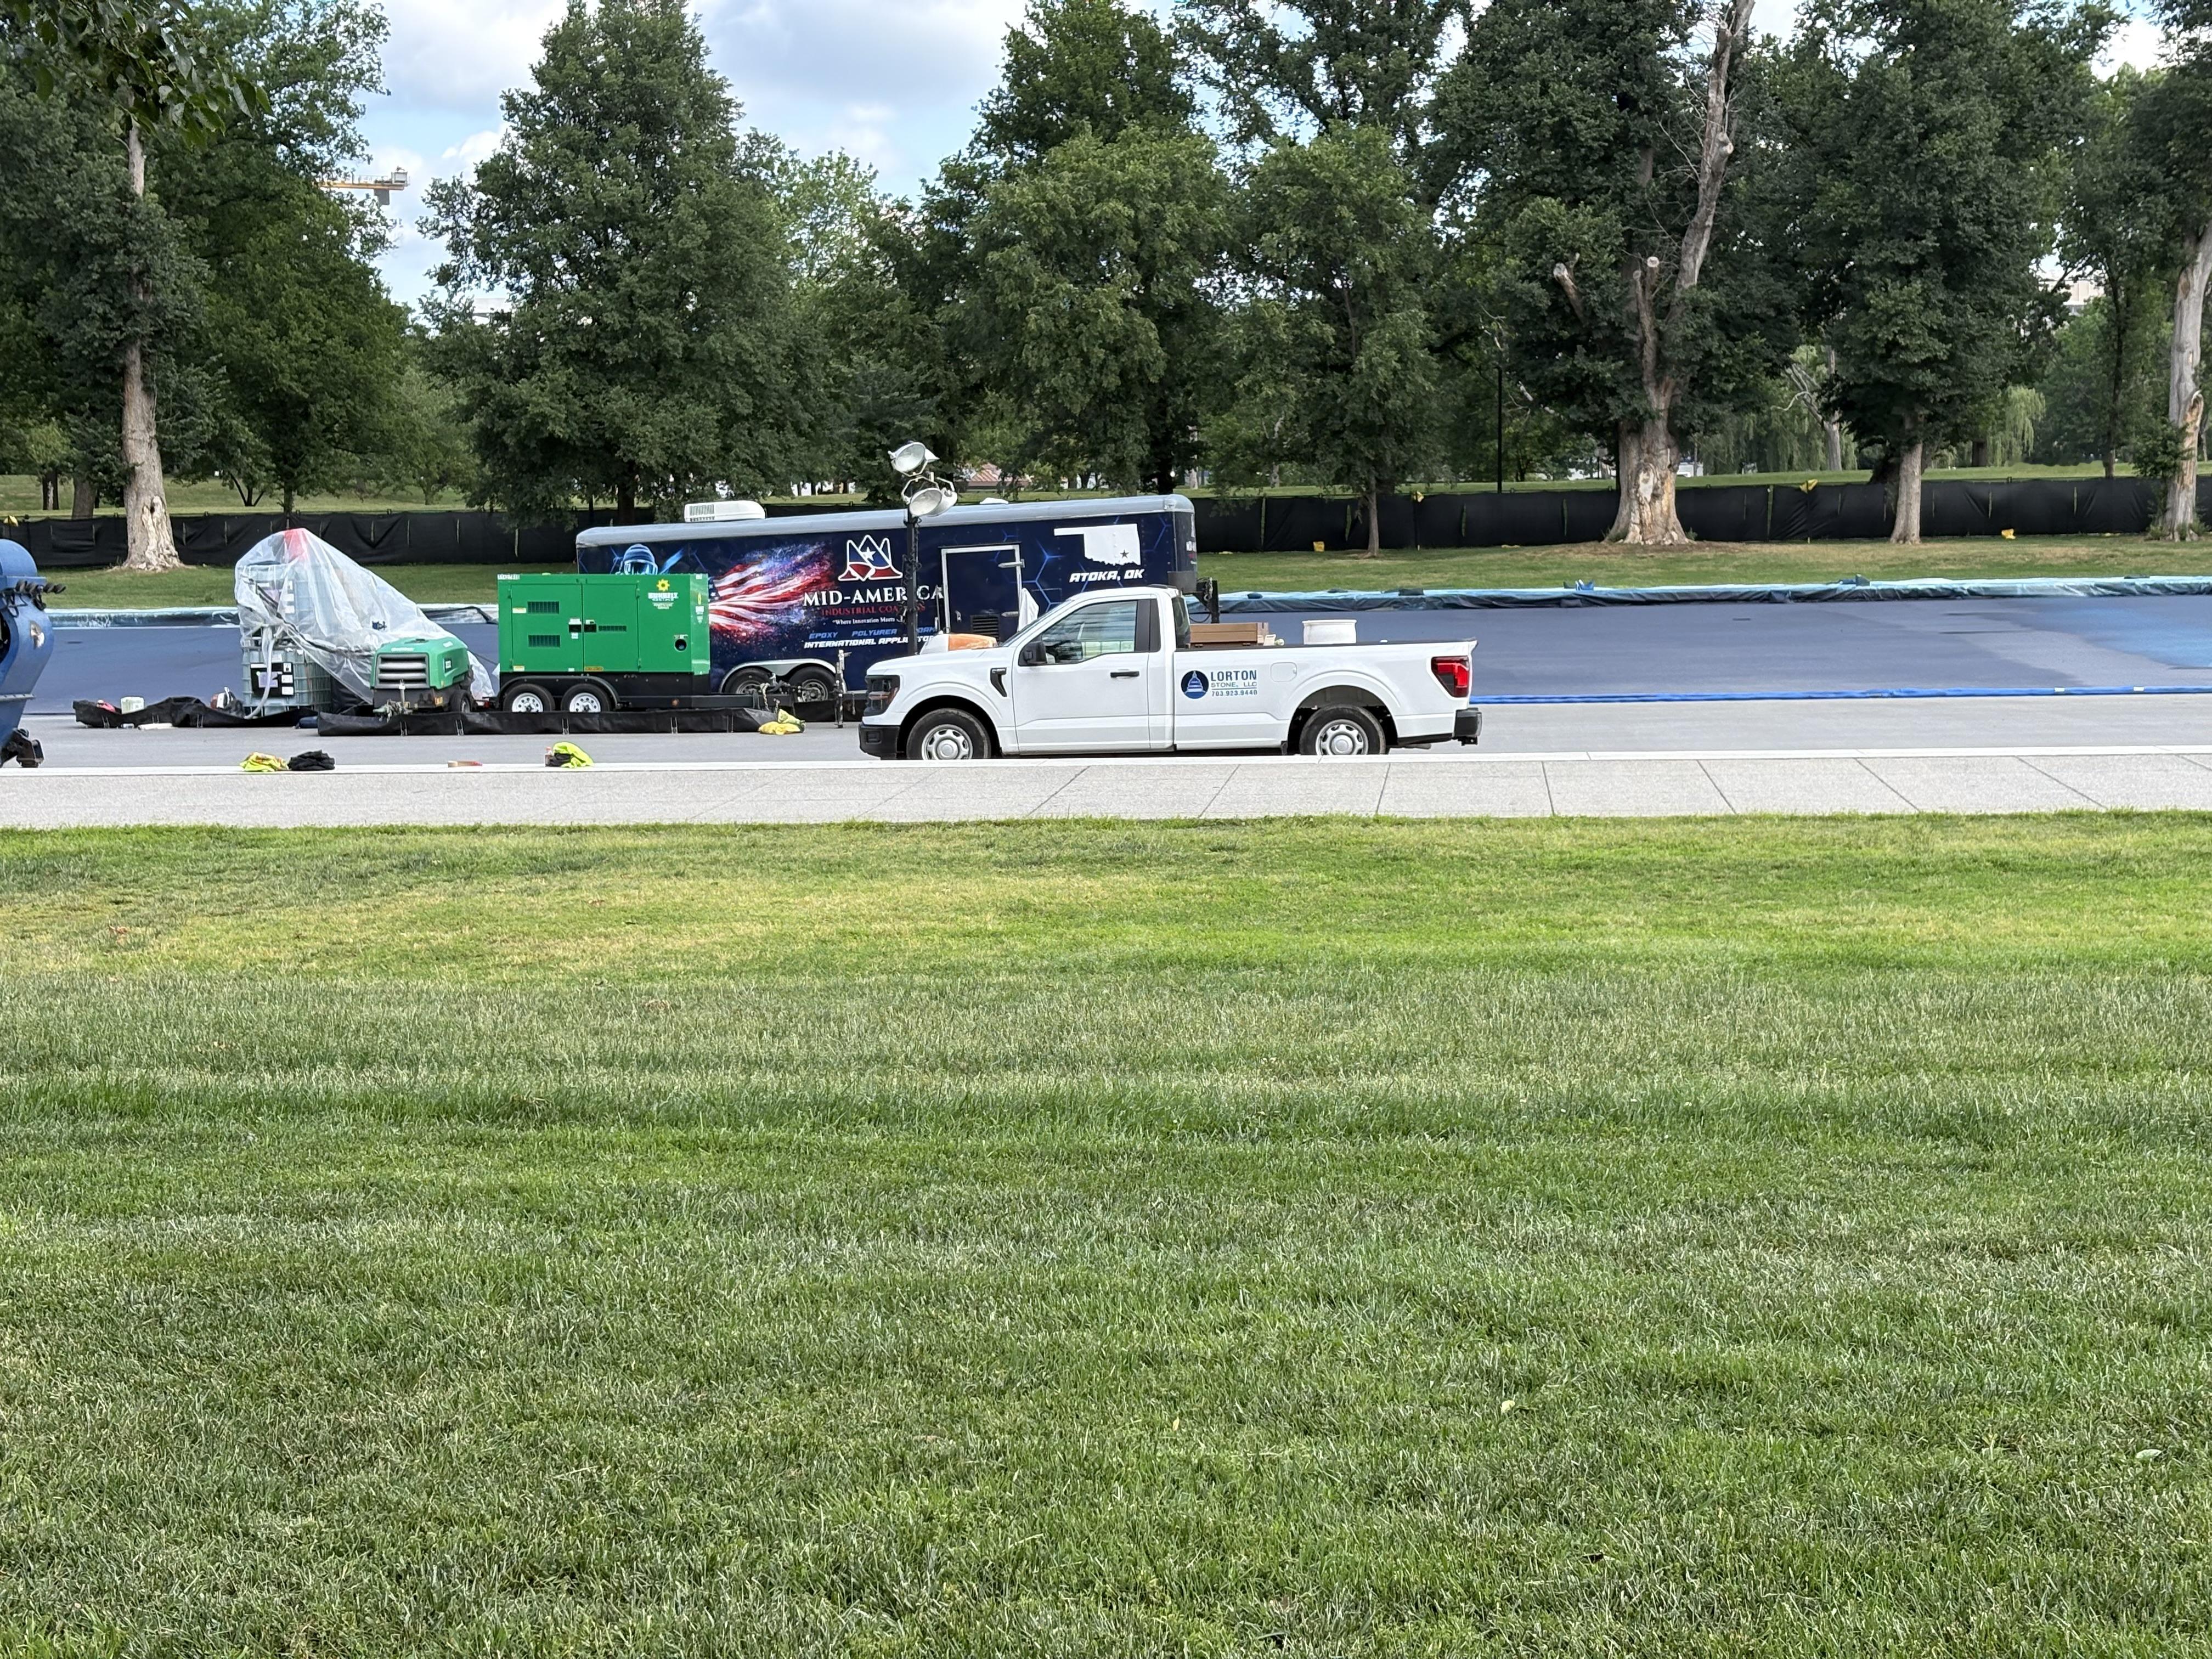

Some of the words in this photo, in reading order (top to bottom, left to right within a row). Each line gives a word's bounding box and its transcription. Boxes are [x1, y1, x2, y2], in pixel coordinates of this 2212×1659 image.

[1069, 571, 1121, 583] ATOKA,
[1124, 569, 1145, 579] OK
[803, 585, 944, 606] MID-AMERCA
[821, 606, 876, 616] INDUSTRIAL
[851, 629, 898, 637] POLYUREA
[804, 639, 877, 648] INTERNATIONAL
[1210, 670, 1257, 681] LORTON
